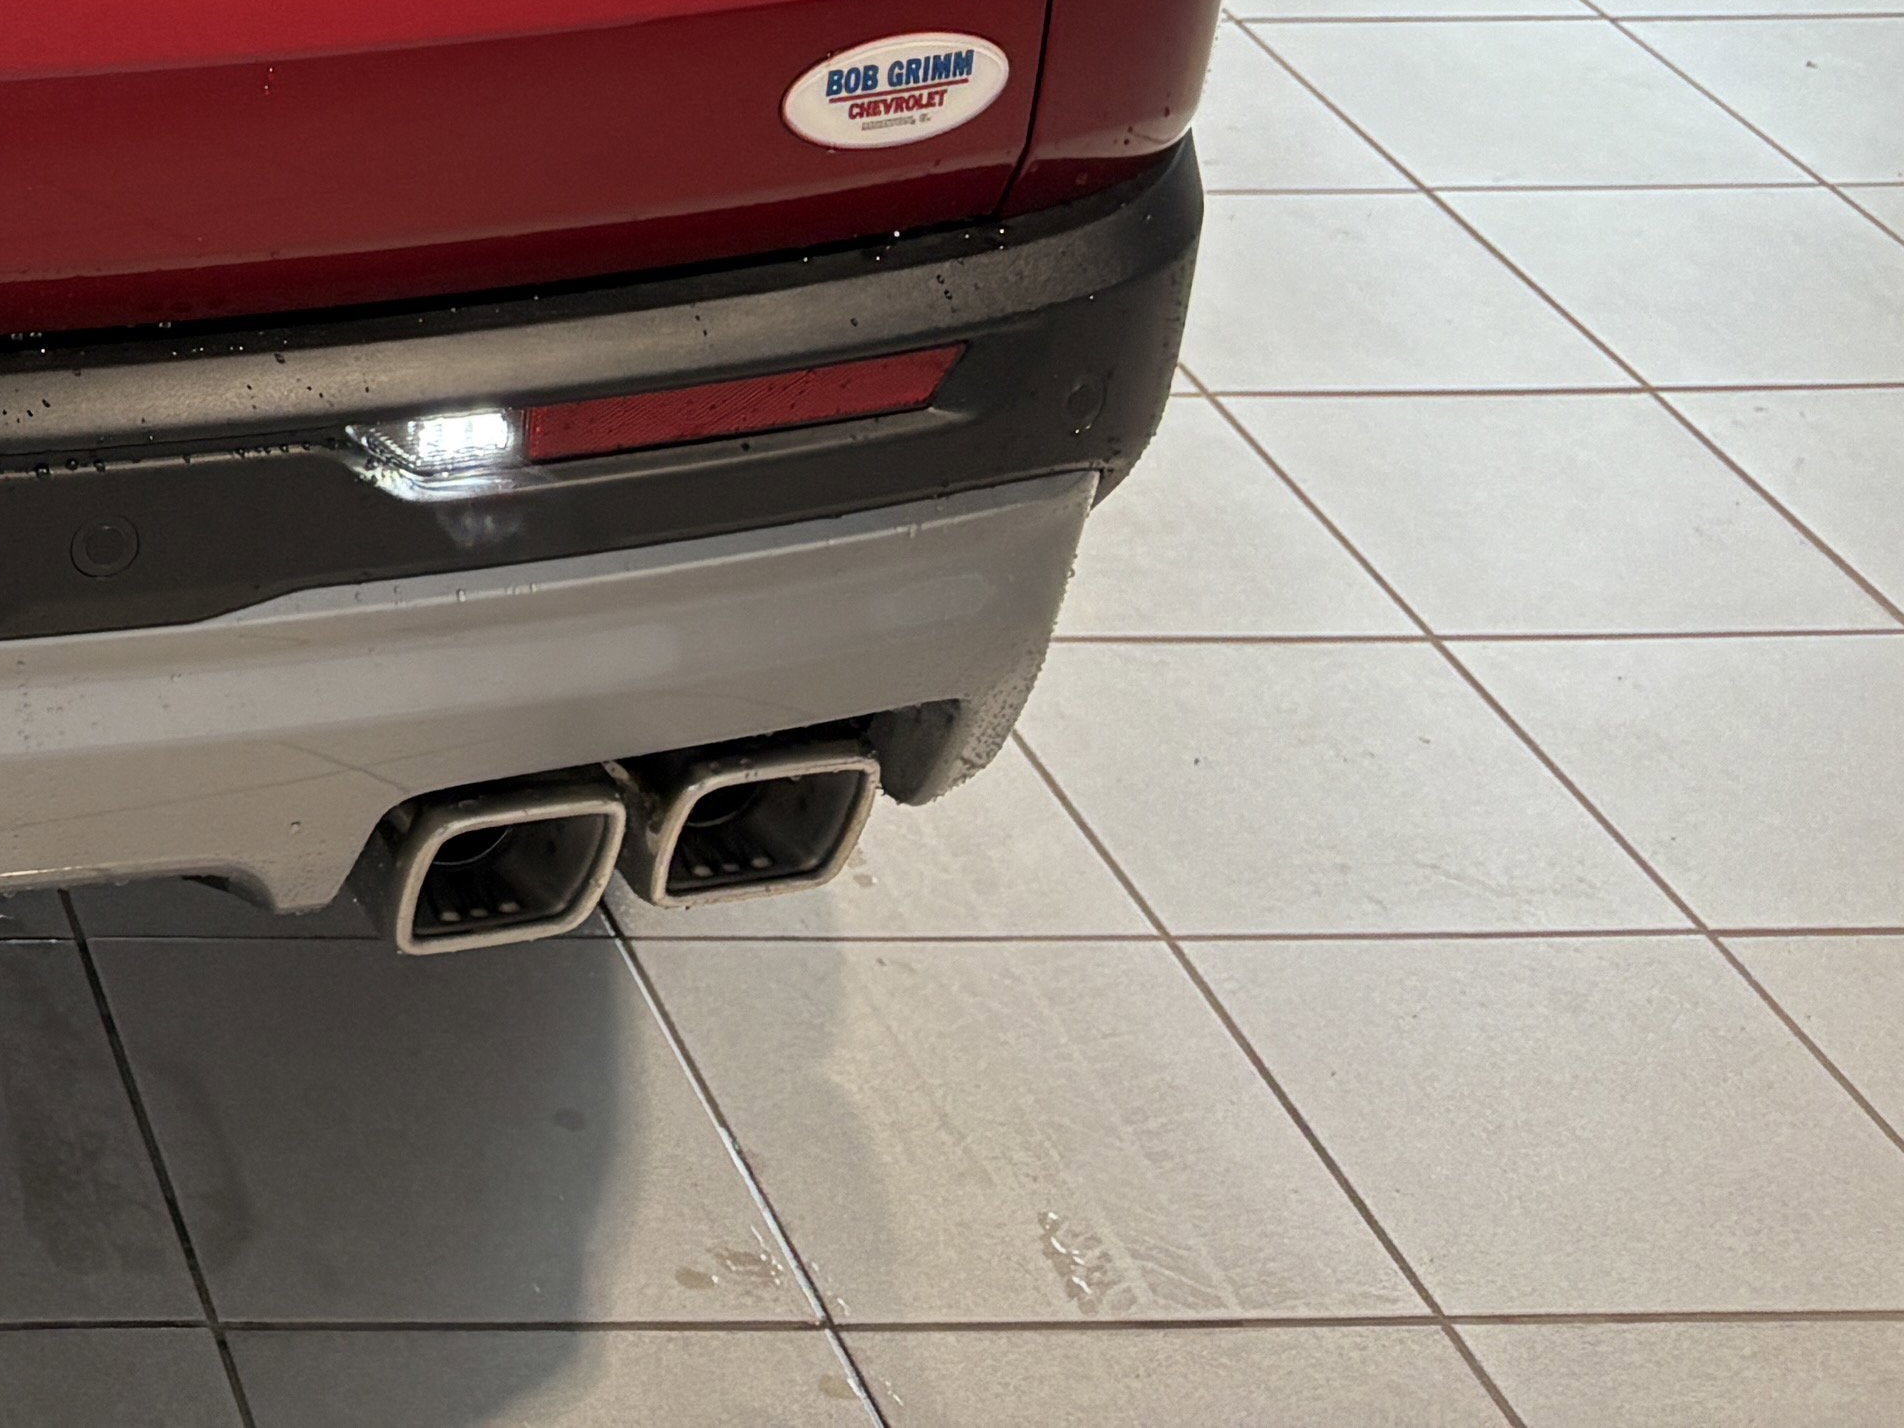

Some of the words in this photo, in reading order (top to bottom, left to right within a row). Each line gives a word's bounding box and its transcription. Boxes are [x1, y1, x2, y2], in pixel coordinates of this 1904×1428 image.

[826, 64, 879, 97] BOB
[887, 49, 974, 88] GRIMM
[848, 89, 948, 120] CHEVROLET
